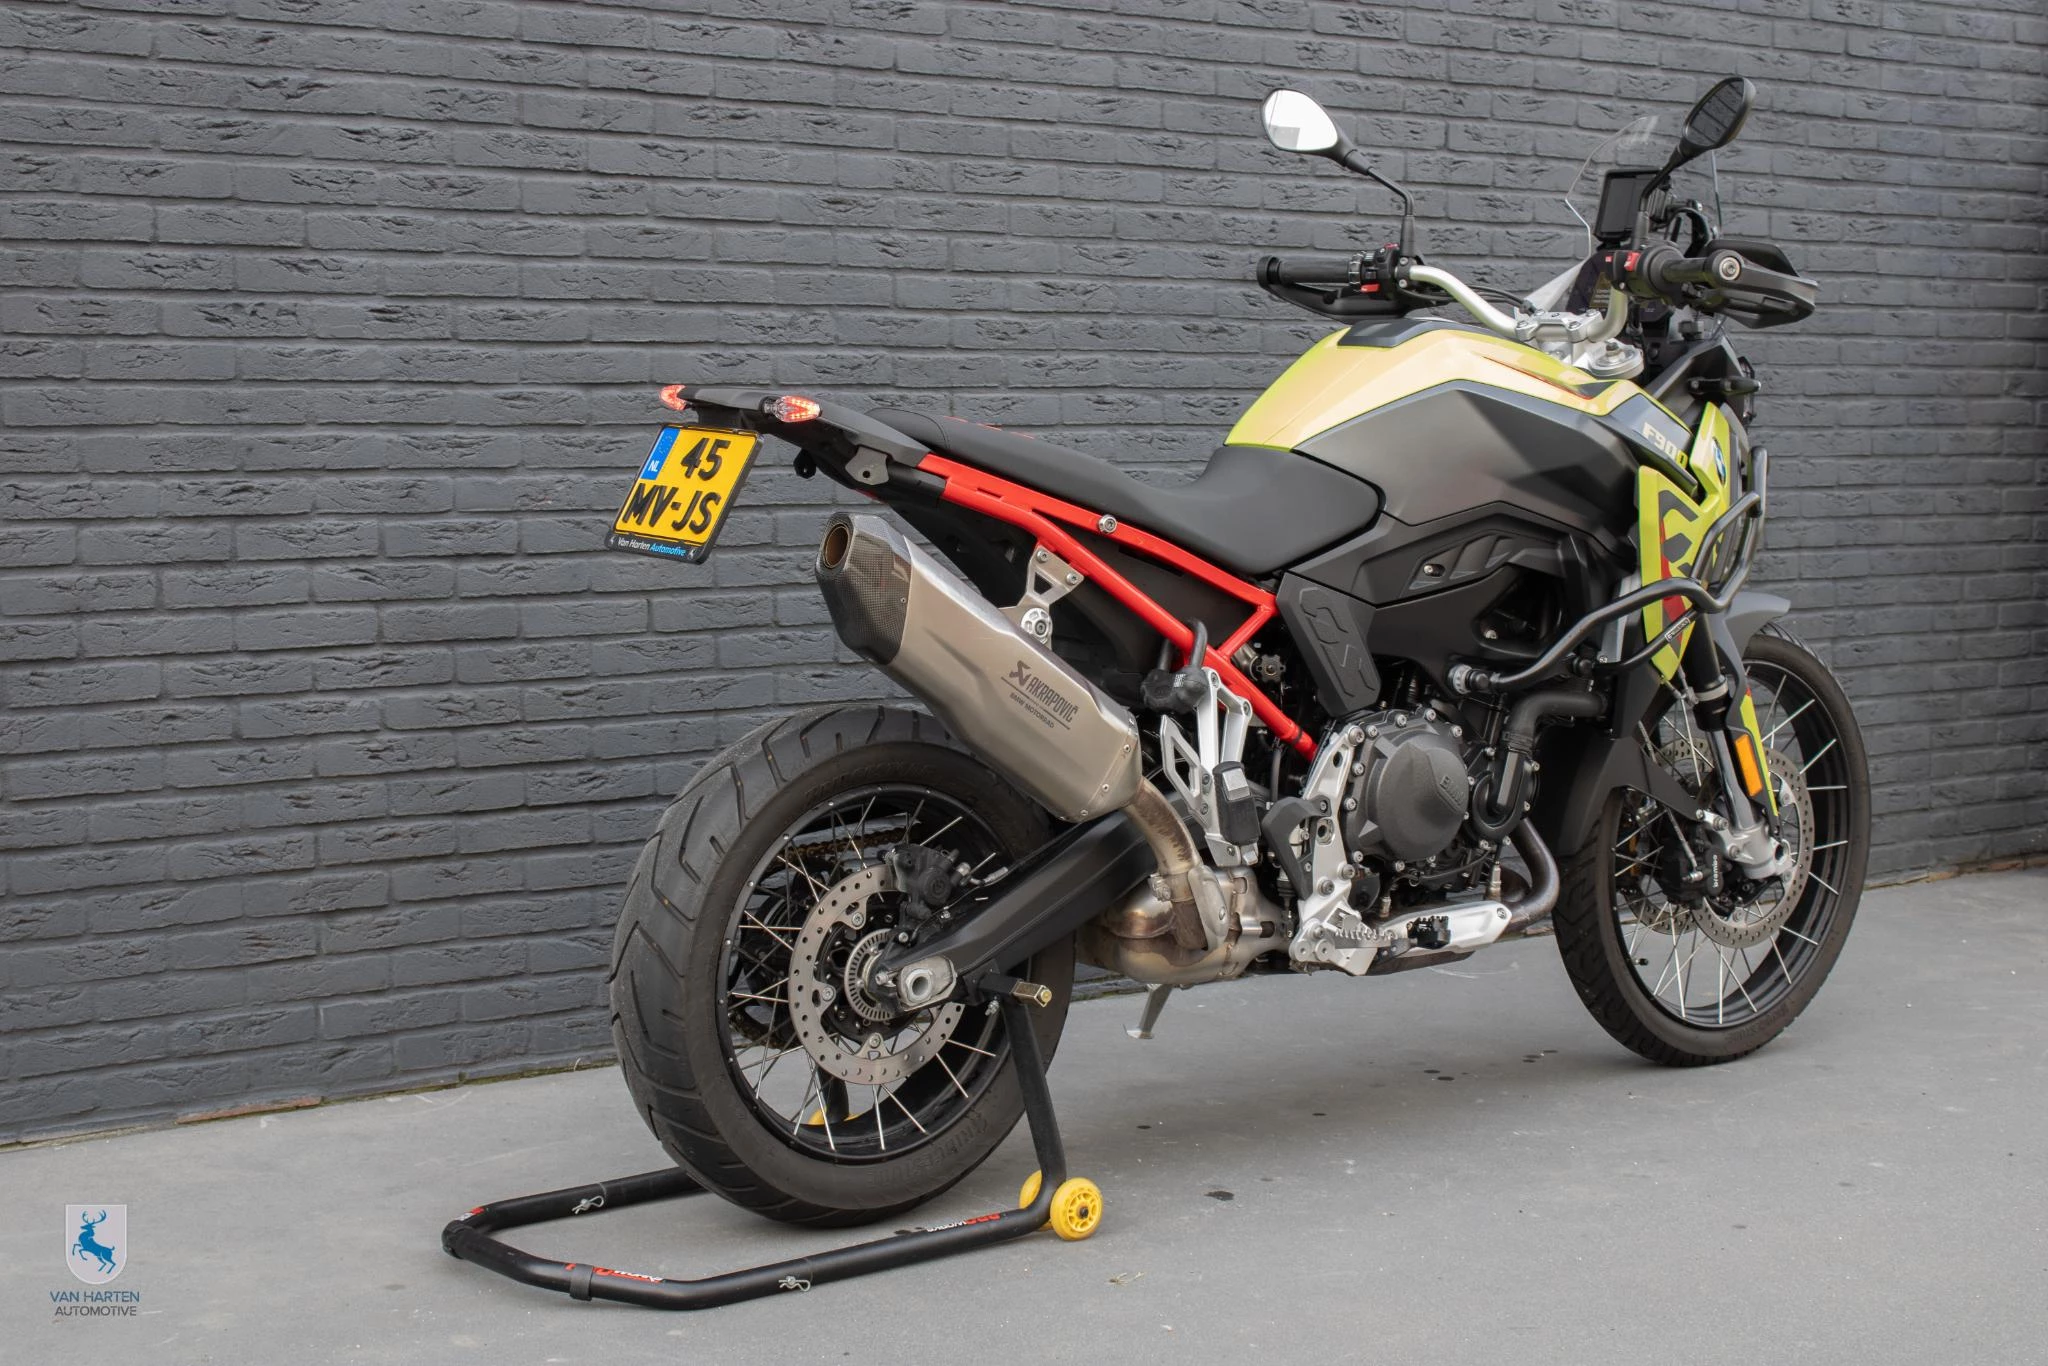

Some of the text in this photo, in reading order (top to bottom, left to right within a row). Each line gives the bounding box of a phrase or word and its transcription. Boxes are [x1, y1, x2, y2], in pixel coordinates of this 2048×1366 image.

[647, 460, 660, 473] NL
[681, 437, 731, 481] 45
[621, 482, 722, 535] MV-JS
[617, 537, 687, 557] Van Harten Automotive
